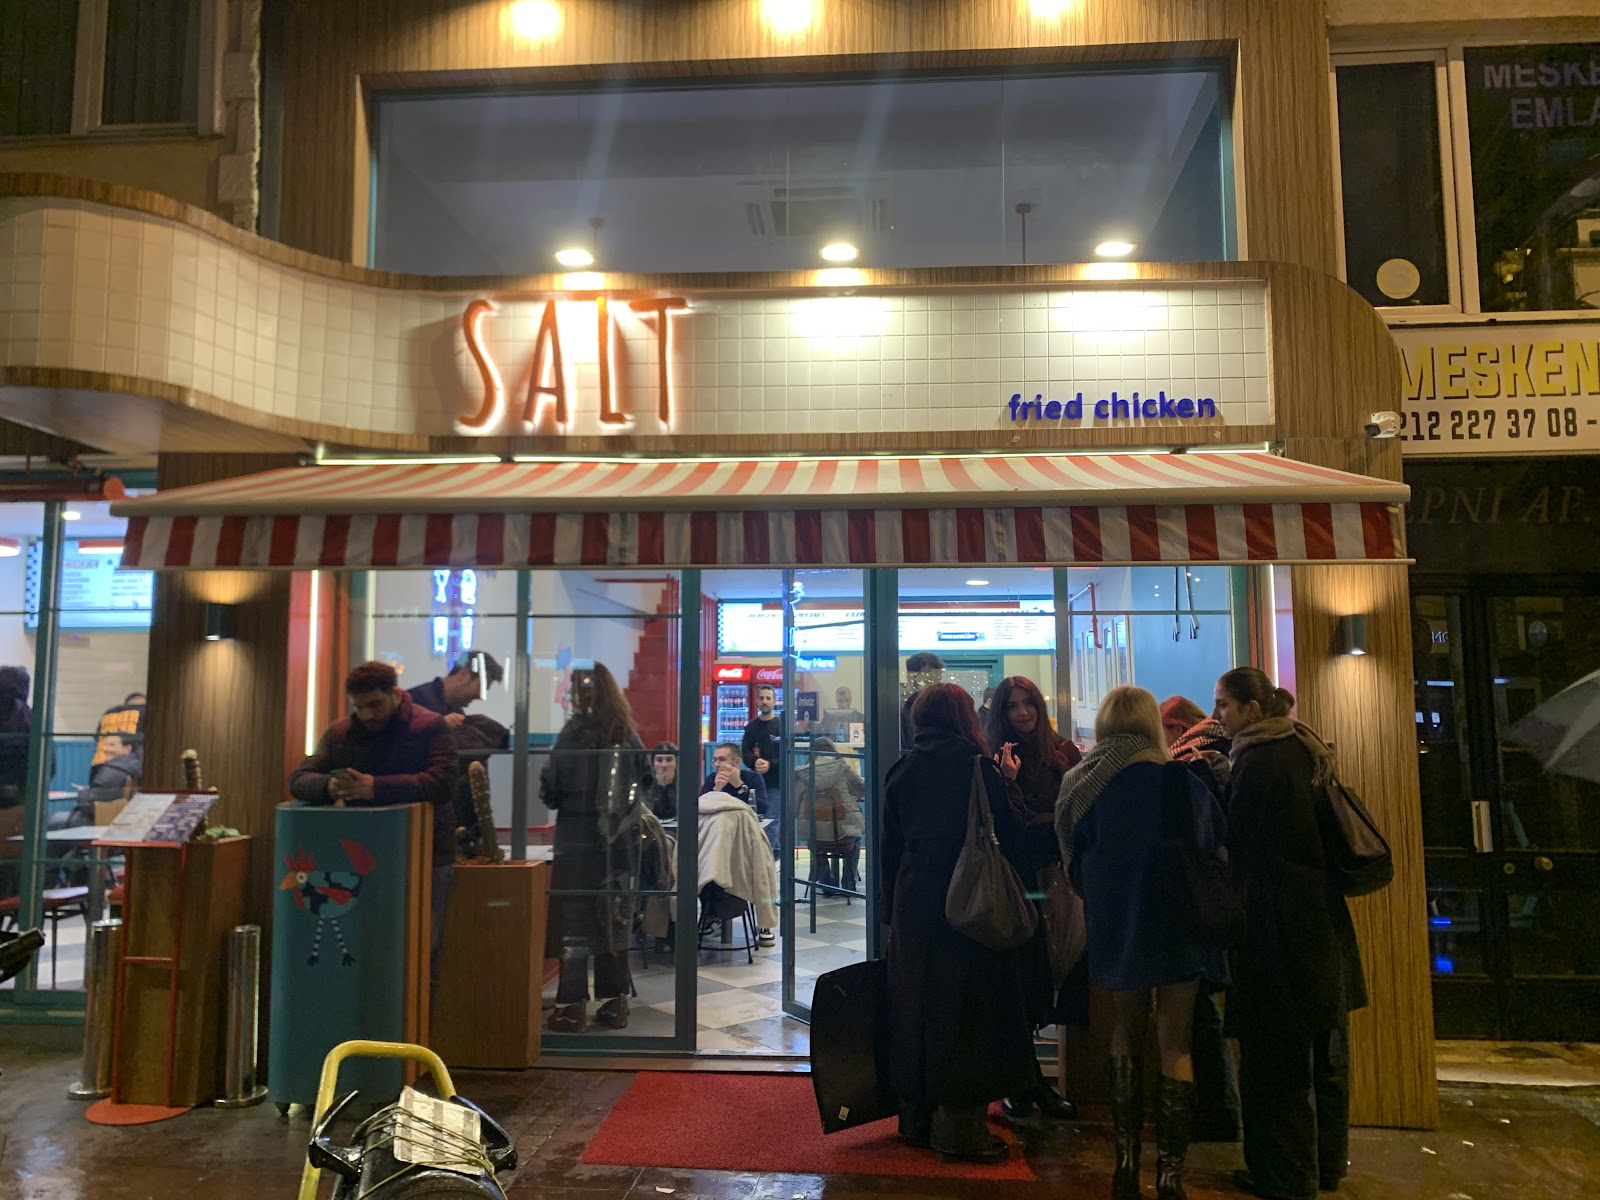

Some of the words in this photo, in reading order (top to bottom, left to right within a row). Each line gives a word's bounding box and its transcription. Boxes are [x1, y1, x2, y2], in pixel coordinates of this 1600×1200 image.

[457, 297, 688, 430] SALT
[1009, 392, 1083, 421] fried
[1094, 391, 1216, 419] chicken
[1450, 409, 1496, 440] 227
[1506, 408, 1536, 439] 37
[1547, 407, 1578, 438] 08
